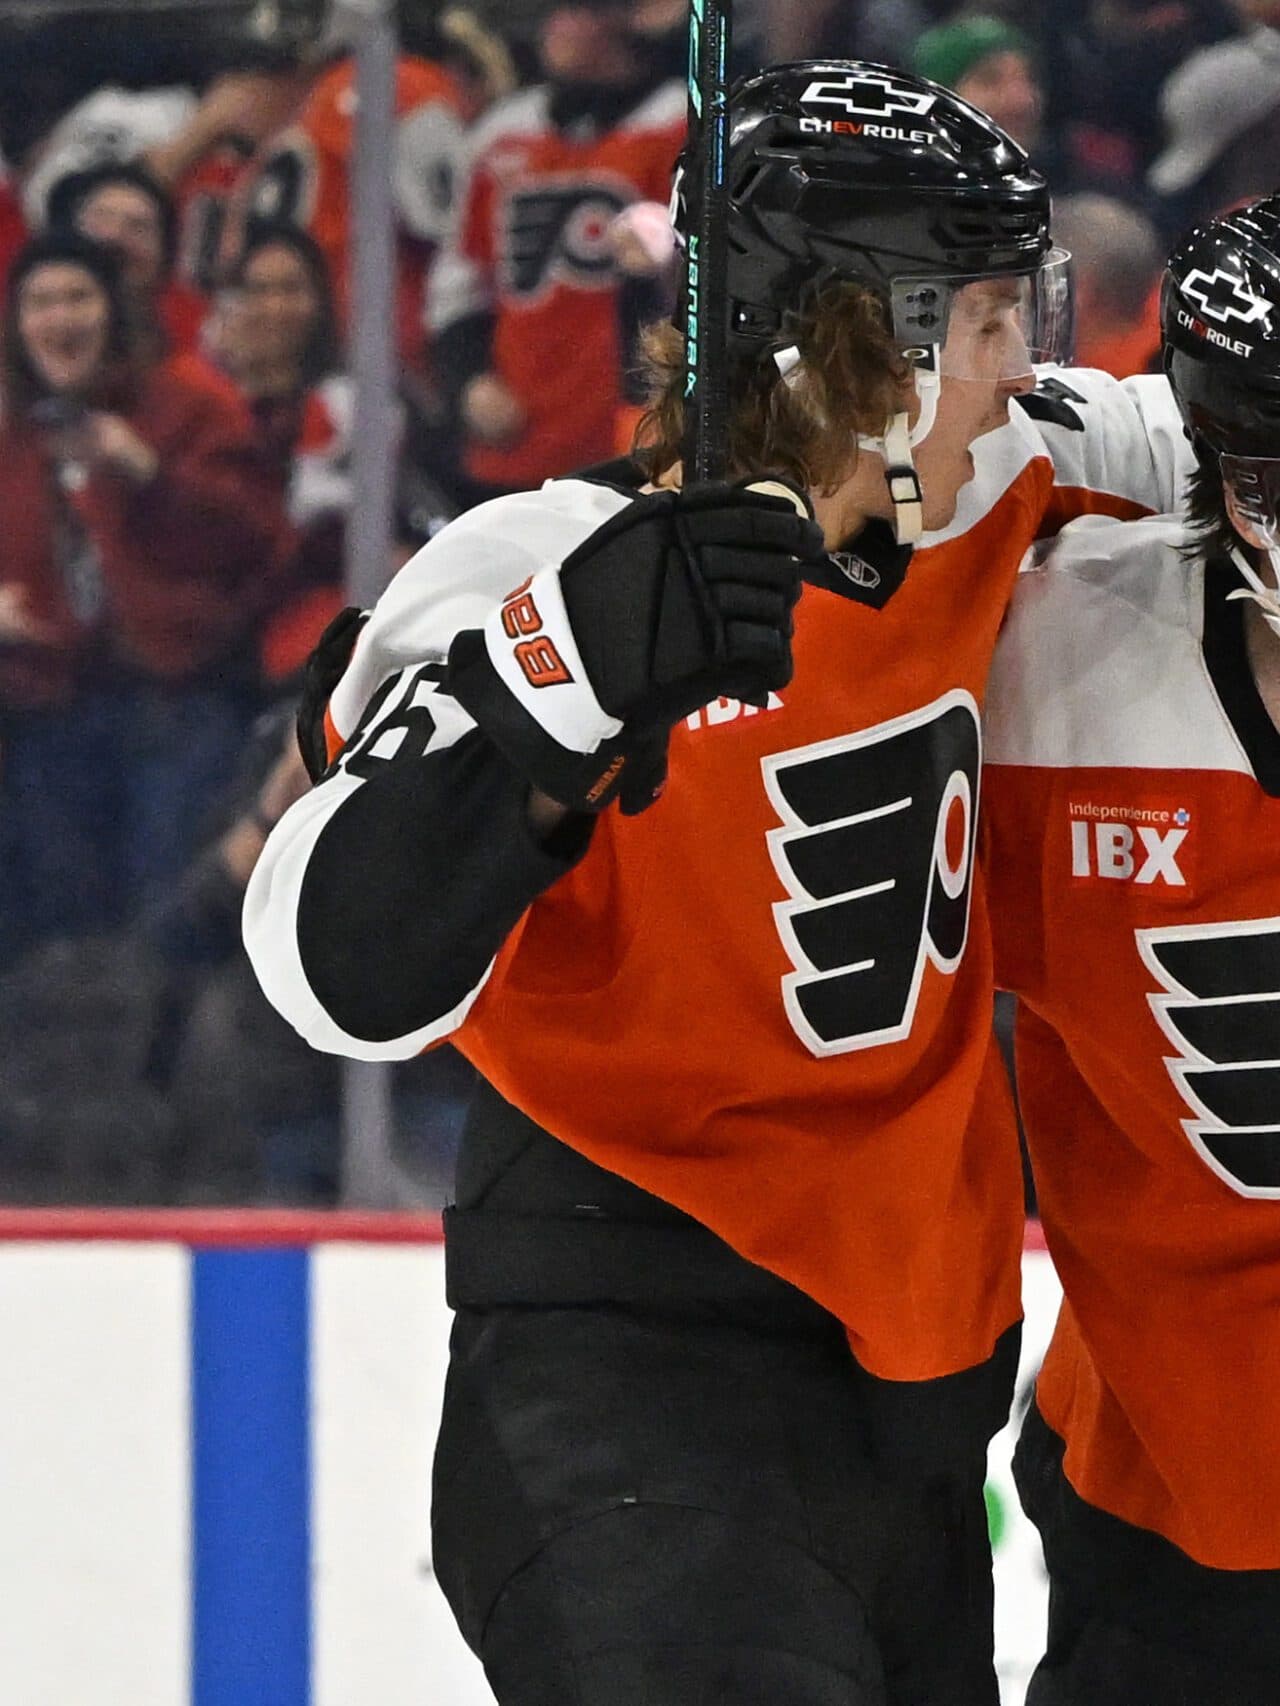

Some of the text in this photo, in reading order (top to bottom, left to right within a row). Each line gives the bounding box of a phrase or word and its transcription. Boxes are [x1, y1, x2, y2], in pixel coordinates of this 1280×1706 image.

[800, 117, 937, 145] CHEVROLET
[1069, 801, 1170, 822] Independence
[1071, 820, 1189, 886] IBX
